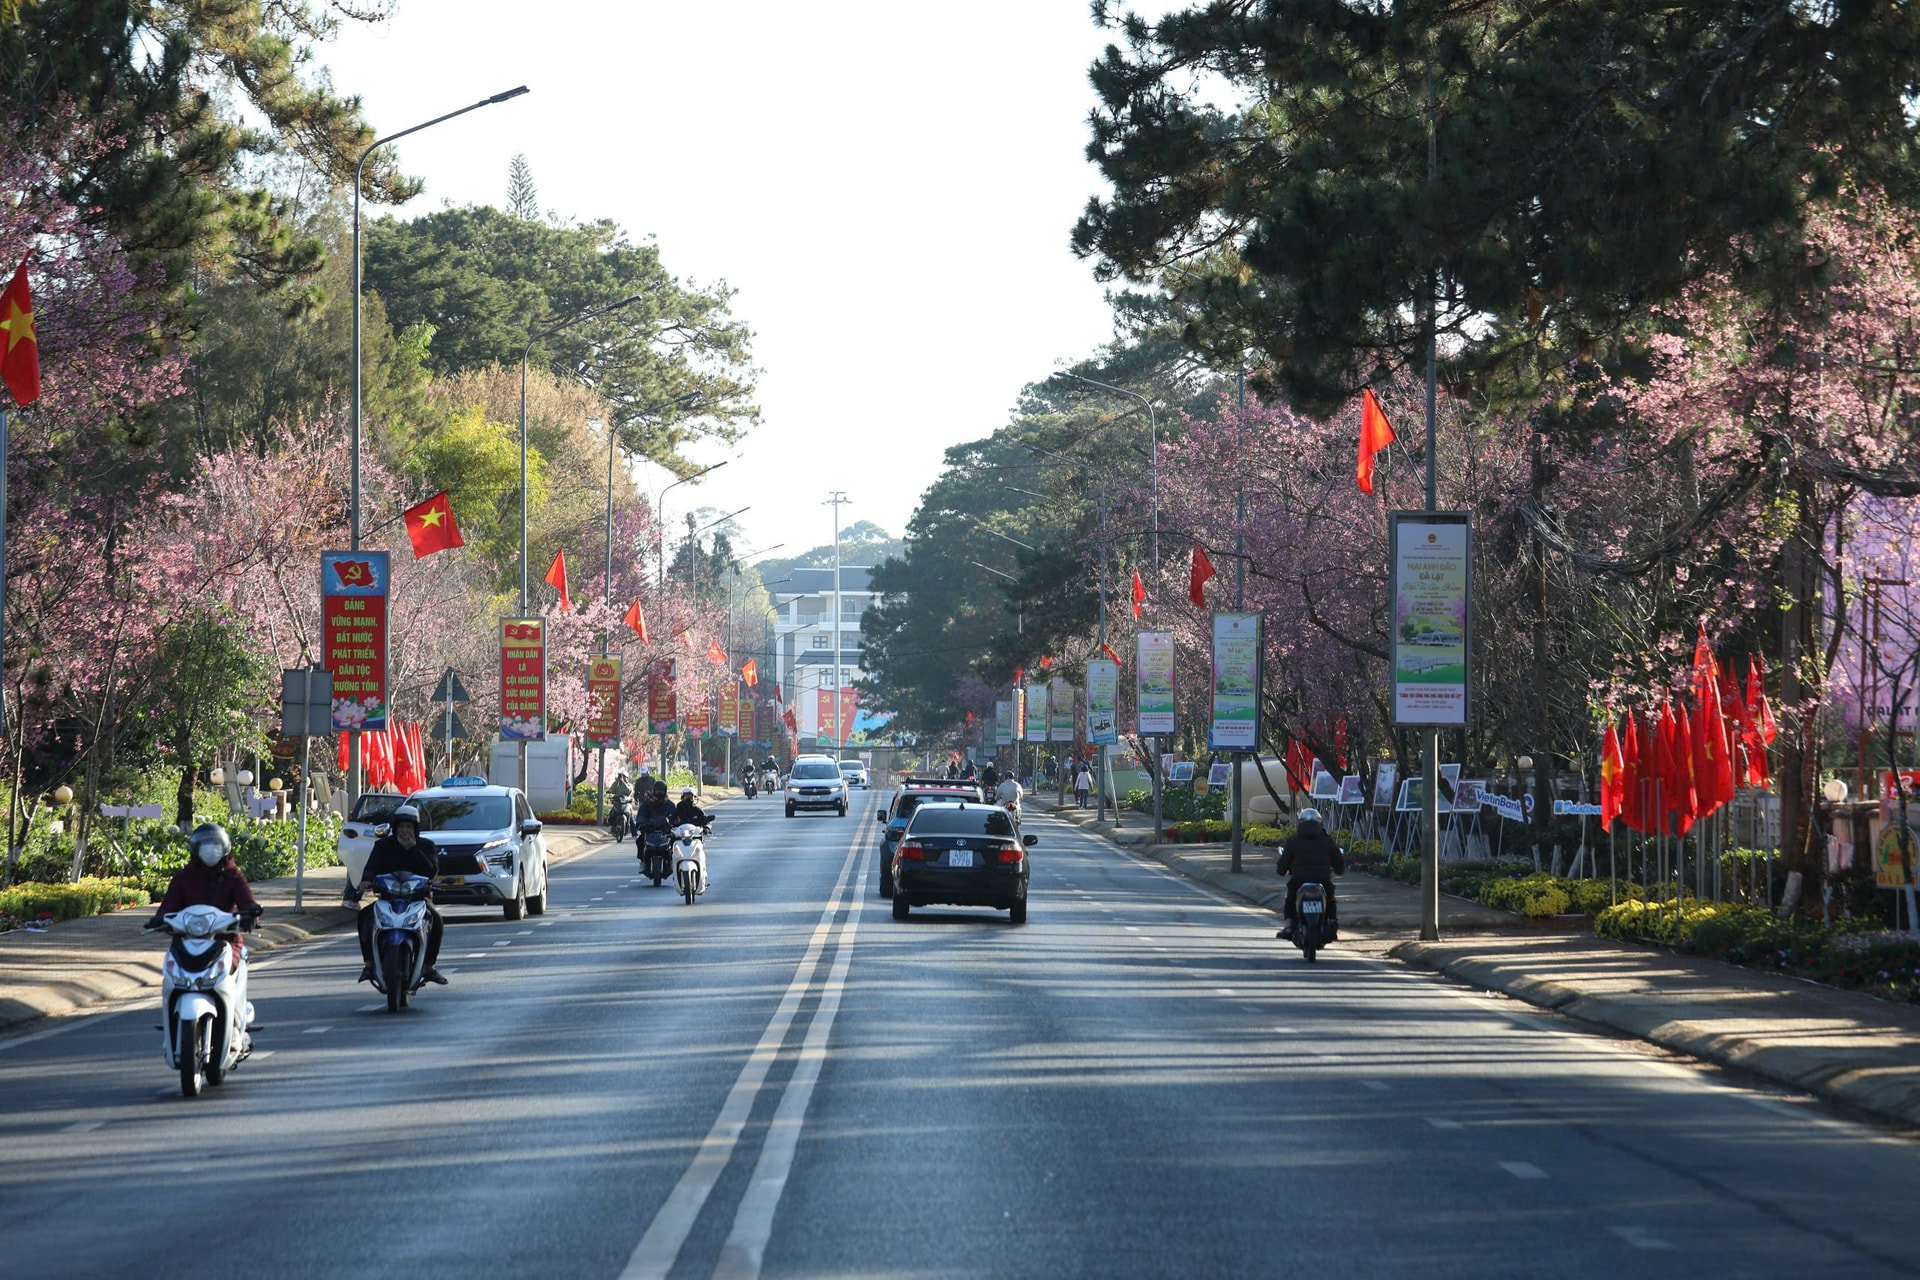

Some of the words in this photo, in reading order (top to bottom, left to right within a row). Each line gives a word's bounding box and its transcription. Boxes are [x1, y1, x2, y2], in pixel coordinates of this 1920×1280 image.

[344, 598, 365, 611] ĐẢNG
[331, 615, 351, 627] VỮNG
[353, 616, 378, 629] MẠNH,
[336, 630, 350, 643] ĐẤT
[352, 631, 373, 643] NƯỚC
[332, 647, 351, 659] PHÁT
[338, 663, 355, 675] DÂN
[356, 664, 371, 677] TỘC
[1477, 790, 1521, 812] VietinBank
